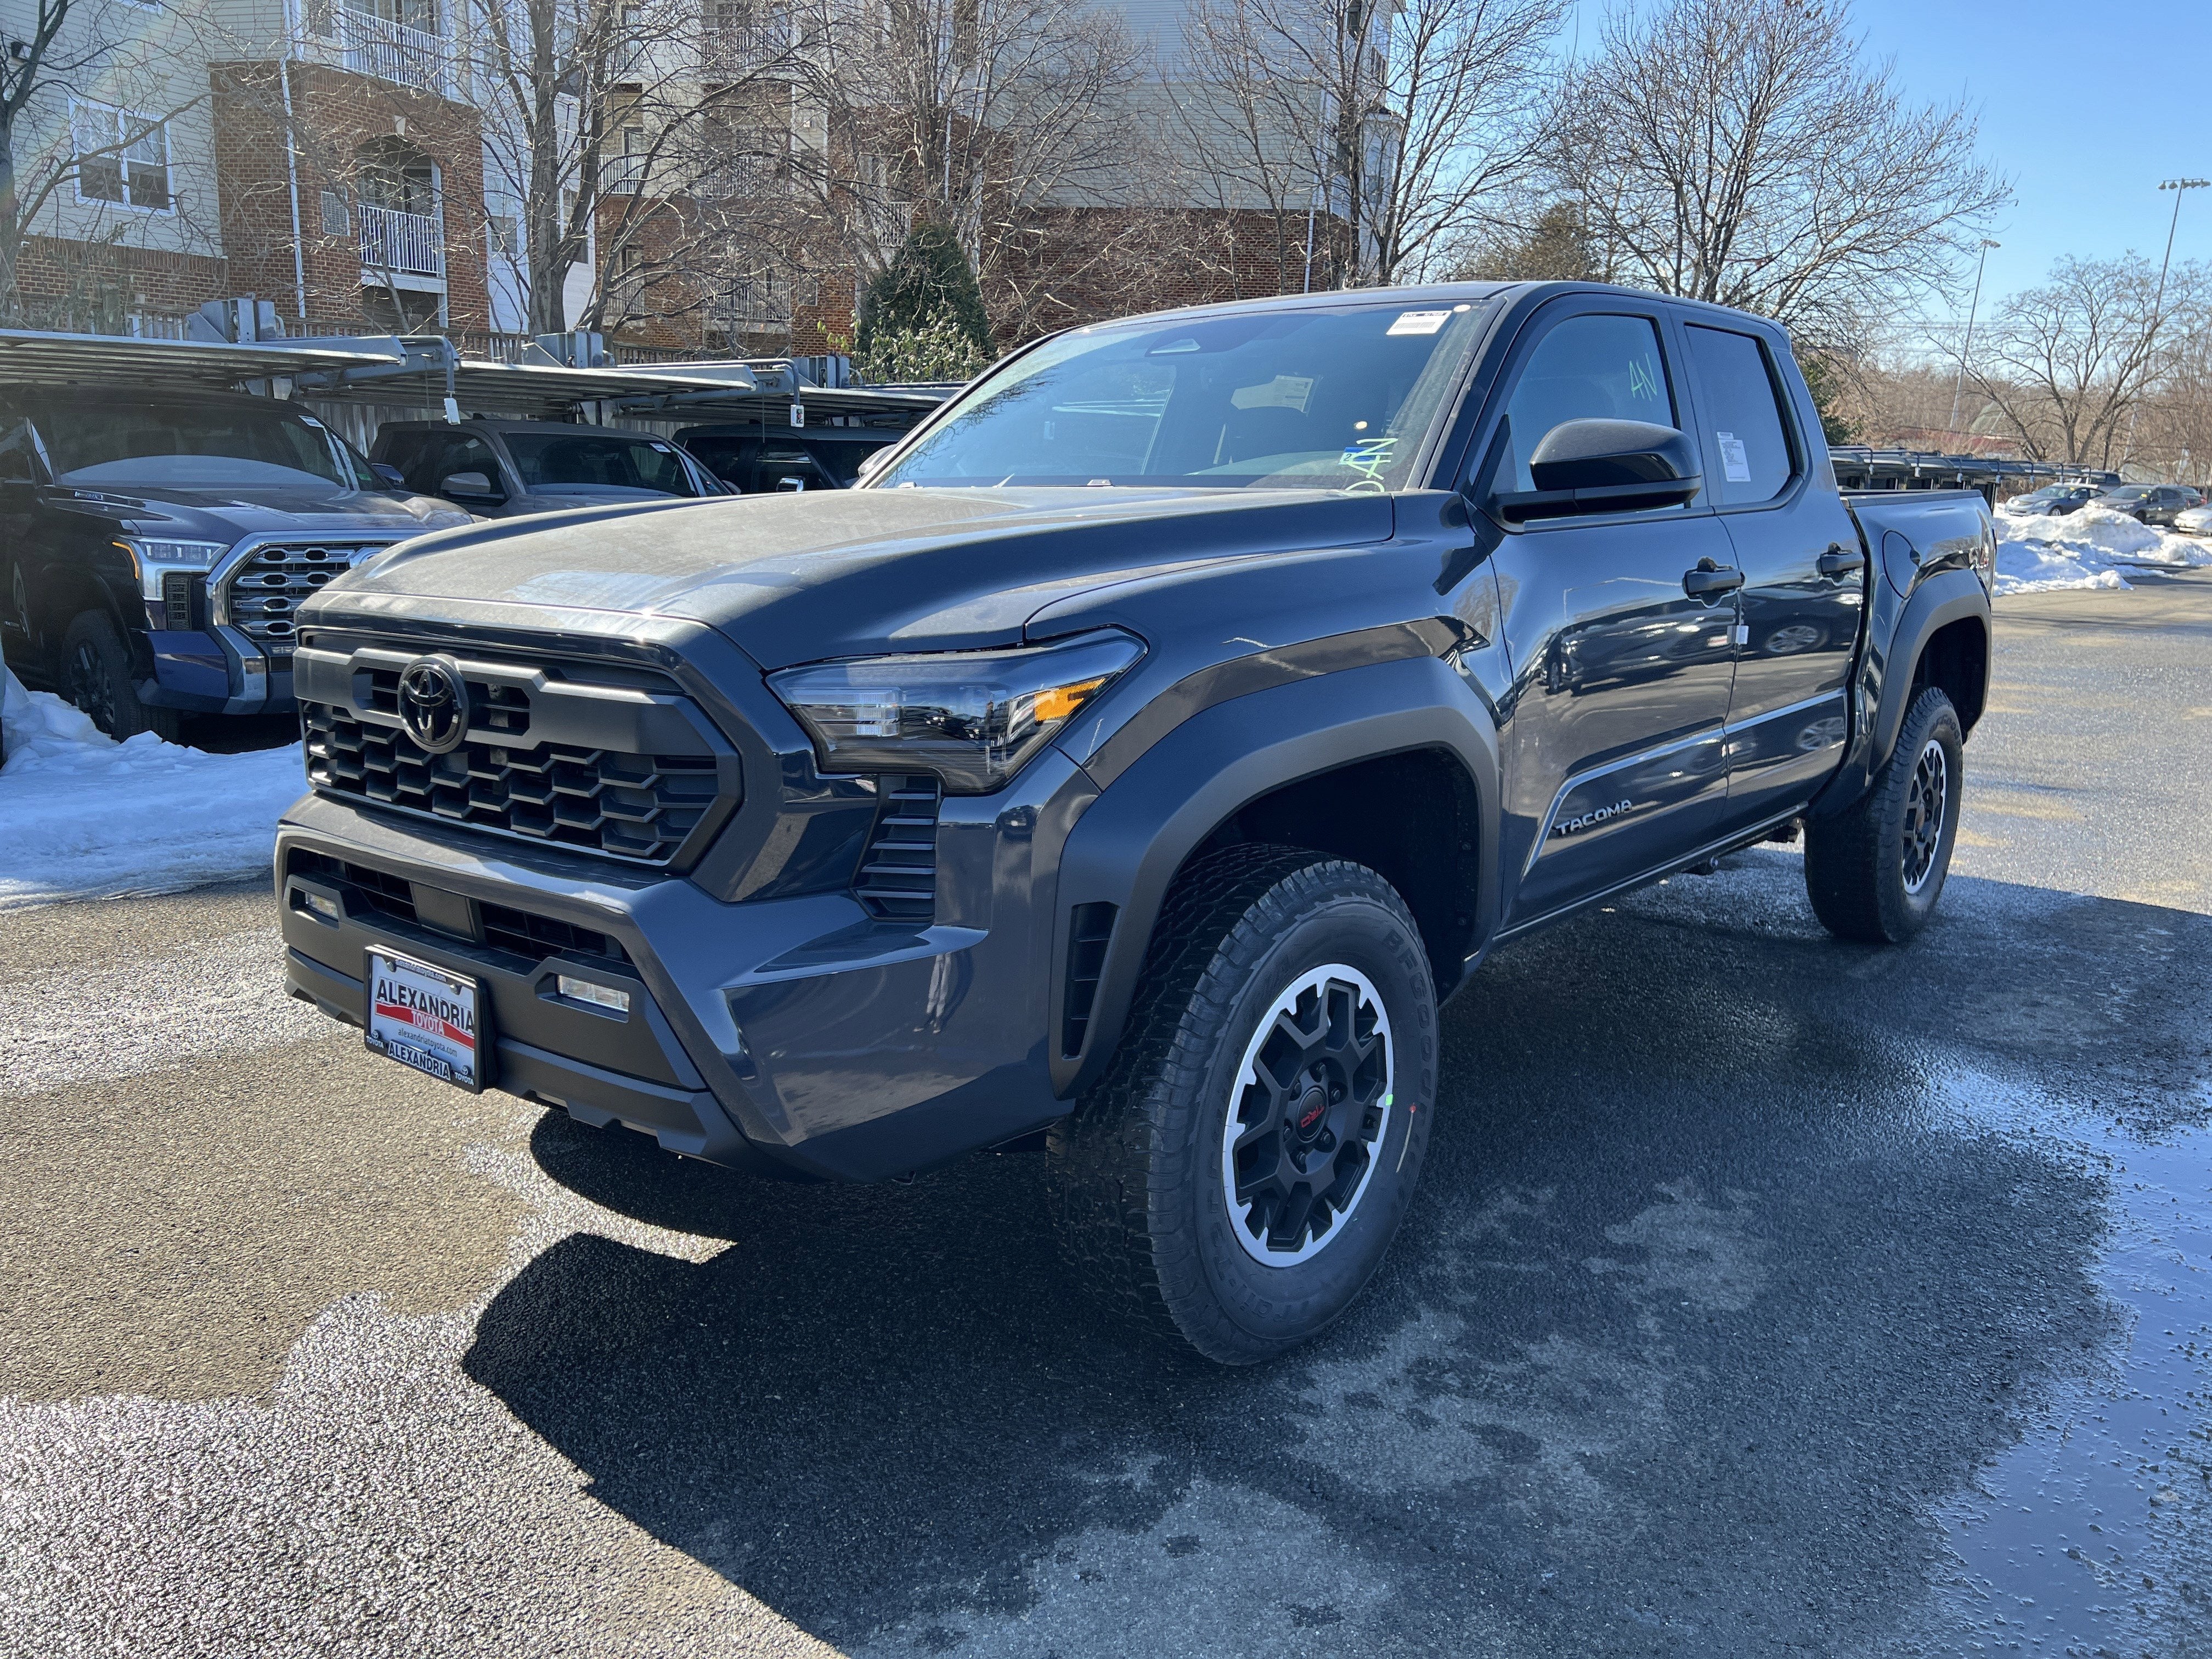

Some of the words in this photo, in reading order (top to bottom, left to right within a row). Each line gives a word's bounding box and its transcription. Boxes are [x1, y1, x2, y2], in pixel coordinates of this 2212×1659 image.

[1555, 799, 1633, 835] TACOMA
[376, 978, 475, 1031] ALEXANDRIA
[411, 1010, 445, 1036] TOYOTA
[366, 1035, 384, 1049] TOYOTA
[398, 1028, 458, 1058] alexandriatoyota.com
[389, 1042, 450, 1080] ALEXANDRIA
[455, 1072, 475, 1086] TOYOTA
